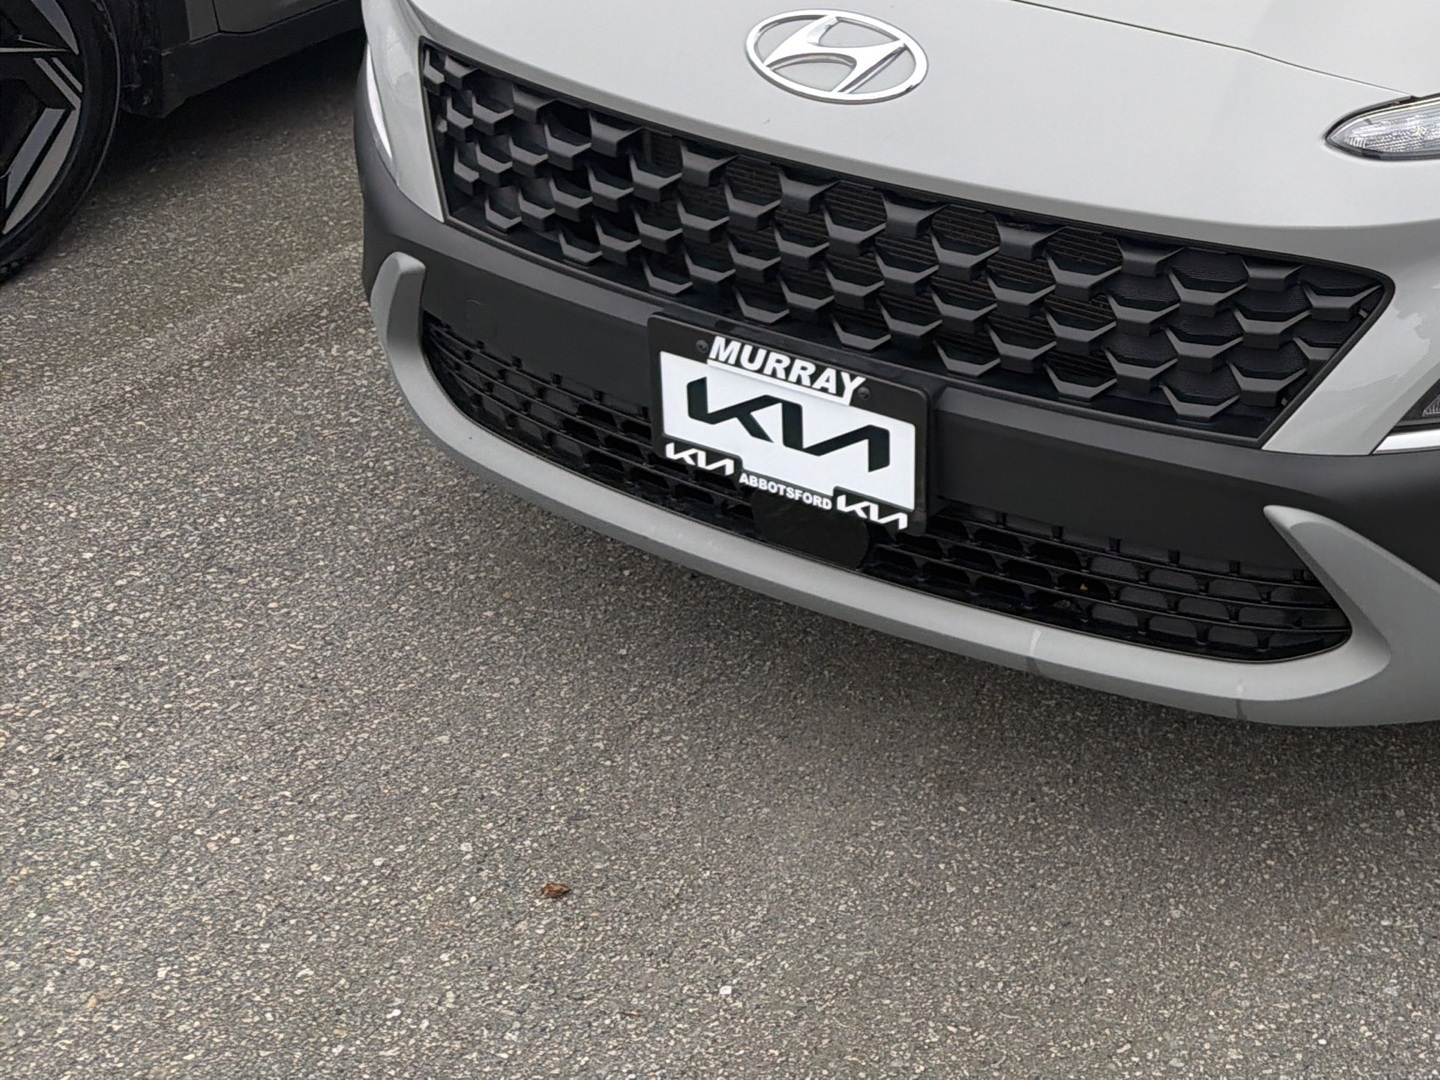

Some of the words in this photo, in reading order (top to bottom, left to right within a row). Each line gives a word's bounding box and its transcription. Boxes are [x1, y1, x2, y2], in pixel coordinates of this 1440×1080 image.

[708, 335, 866, 406] MURRAY
[687, 376, 890, 473] KIA
[665, 442, 734, 476] KIA
[739, 472, 832, 511] ABBOTSFORD
[836, 494, 908, 530] KIA
